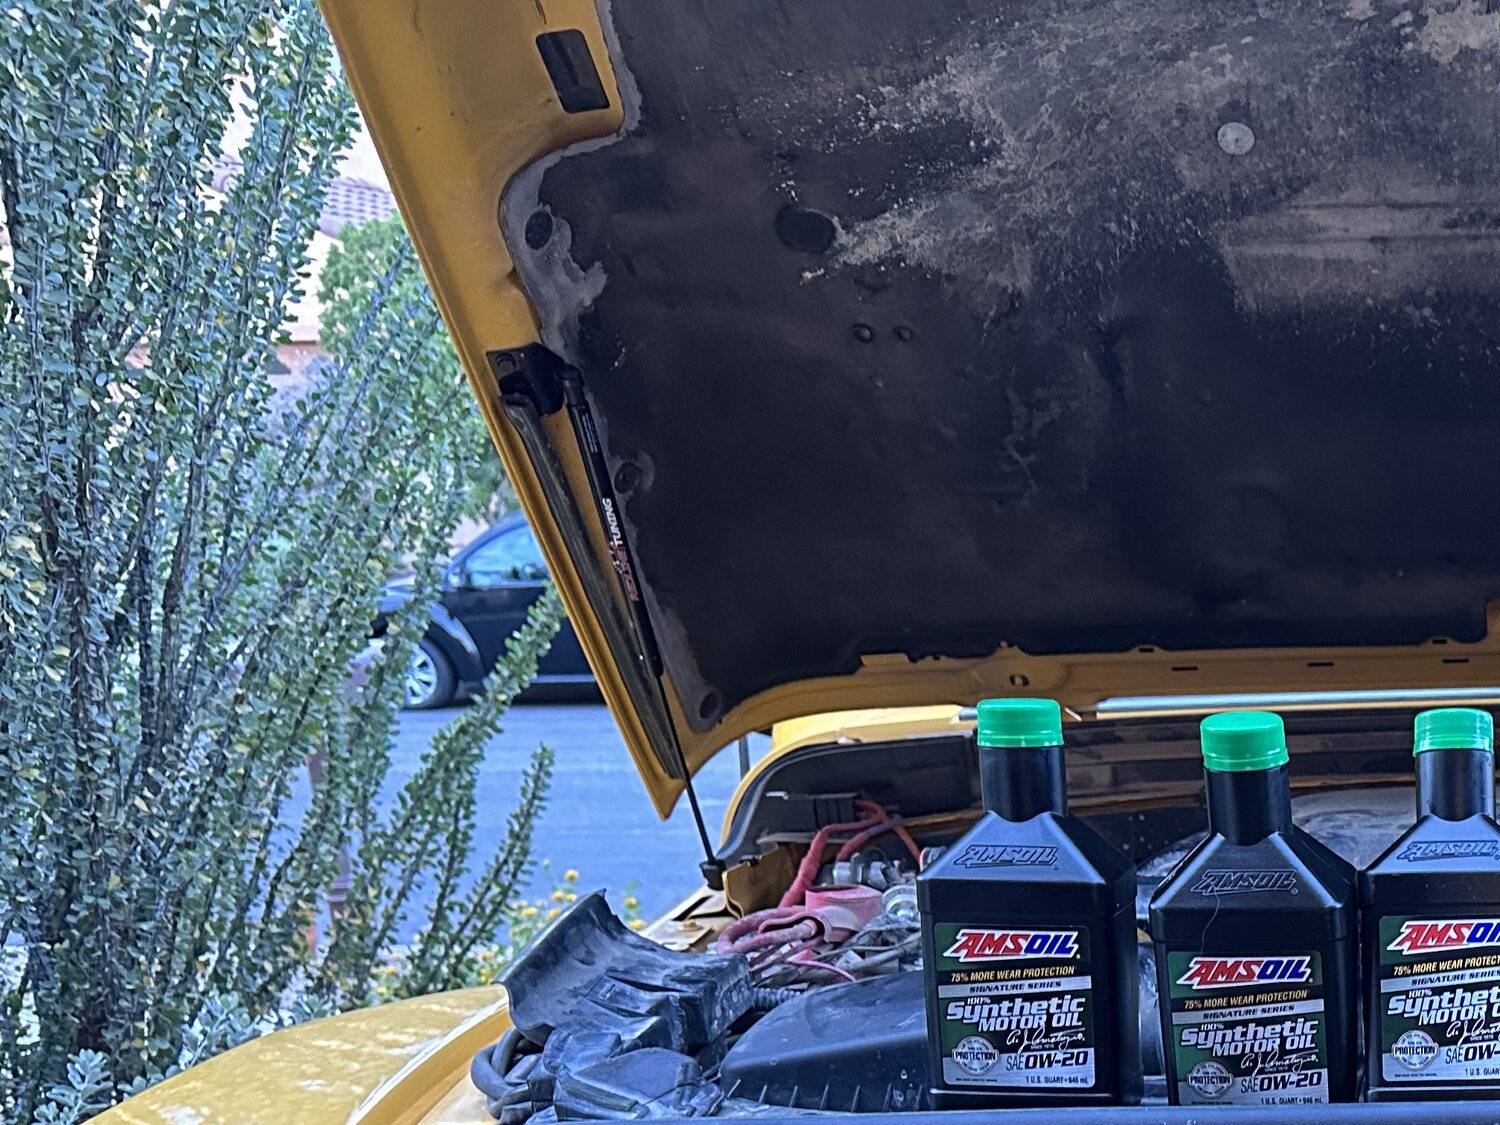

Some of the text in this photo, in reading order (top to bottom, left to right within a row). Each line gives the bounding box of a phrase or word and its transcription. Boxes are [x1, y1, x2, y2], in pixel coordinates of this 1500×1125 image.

[602, 498, 624, 546] TUNING
[953, 845, 1059, 869] AMSOIL
[1396, 840, 1499, 862] AMSOIL
[1190, 868, 1297, 895] AMSOIL
[943, 929, 1079, 962] AMSOIL
[951, 966, 1074, 982] 75% MORE WEAR PROTECTION
[1177, 956, 1311, 990] AMSOIL
[1394, 967, 1410, 976] 75%
[1413, 963, 1436, 973] MORE
[1439, 960, 1462, 970] WEAR
[970, 981, 1061, 993] SIGNATURE SERIES
[1412, 974, 1465, 985] SIGNATURE
[967, 997, 990, 1005] 100%
[1185, 990, 1308, 1009] 75% MORE WEAR PROTECTION
[1409, 989, 1431, 997] 100%
[947, 995, 1085, 1023] Synthetic
[1203, 1005, 1294, 1019] SIGNATURE SERIES
[1419, 1007, 1487, 1025] MOTOR
[979, 1013, 1082, 1032] MOTOR OIL
[1181, 1018, 1318, 1048] Synthetic
[956, 1051, 995, 1060] PROTECTION
[1213, 1035, 1315, 1057] MOTOR OIL
[1395, 1045, 1436, 1055] PROTECTION
[1006, 1054, 1023, 1071] SAE
[1025, 1051, 1088, 1069] 0W-20
[1446, 1048, 1462, 1064] SAE
[1190, 1075, 1230, 1085] PROTECTION
[1241, 1072, 1322, 1093] SAE 0W-20
